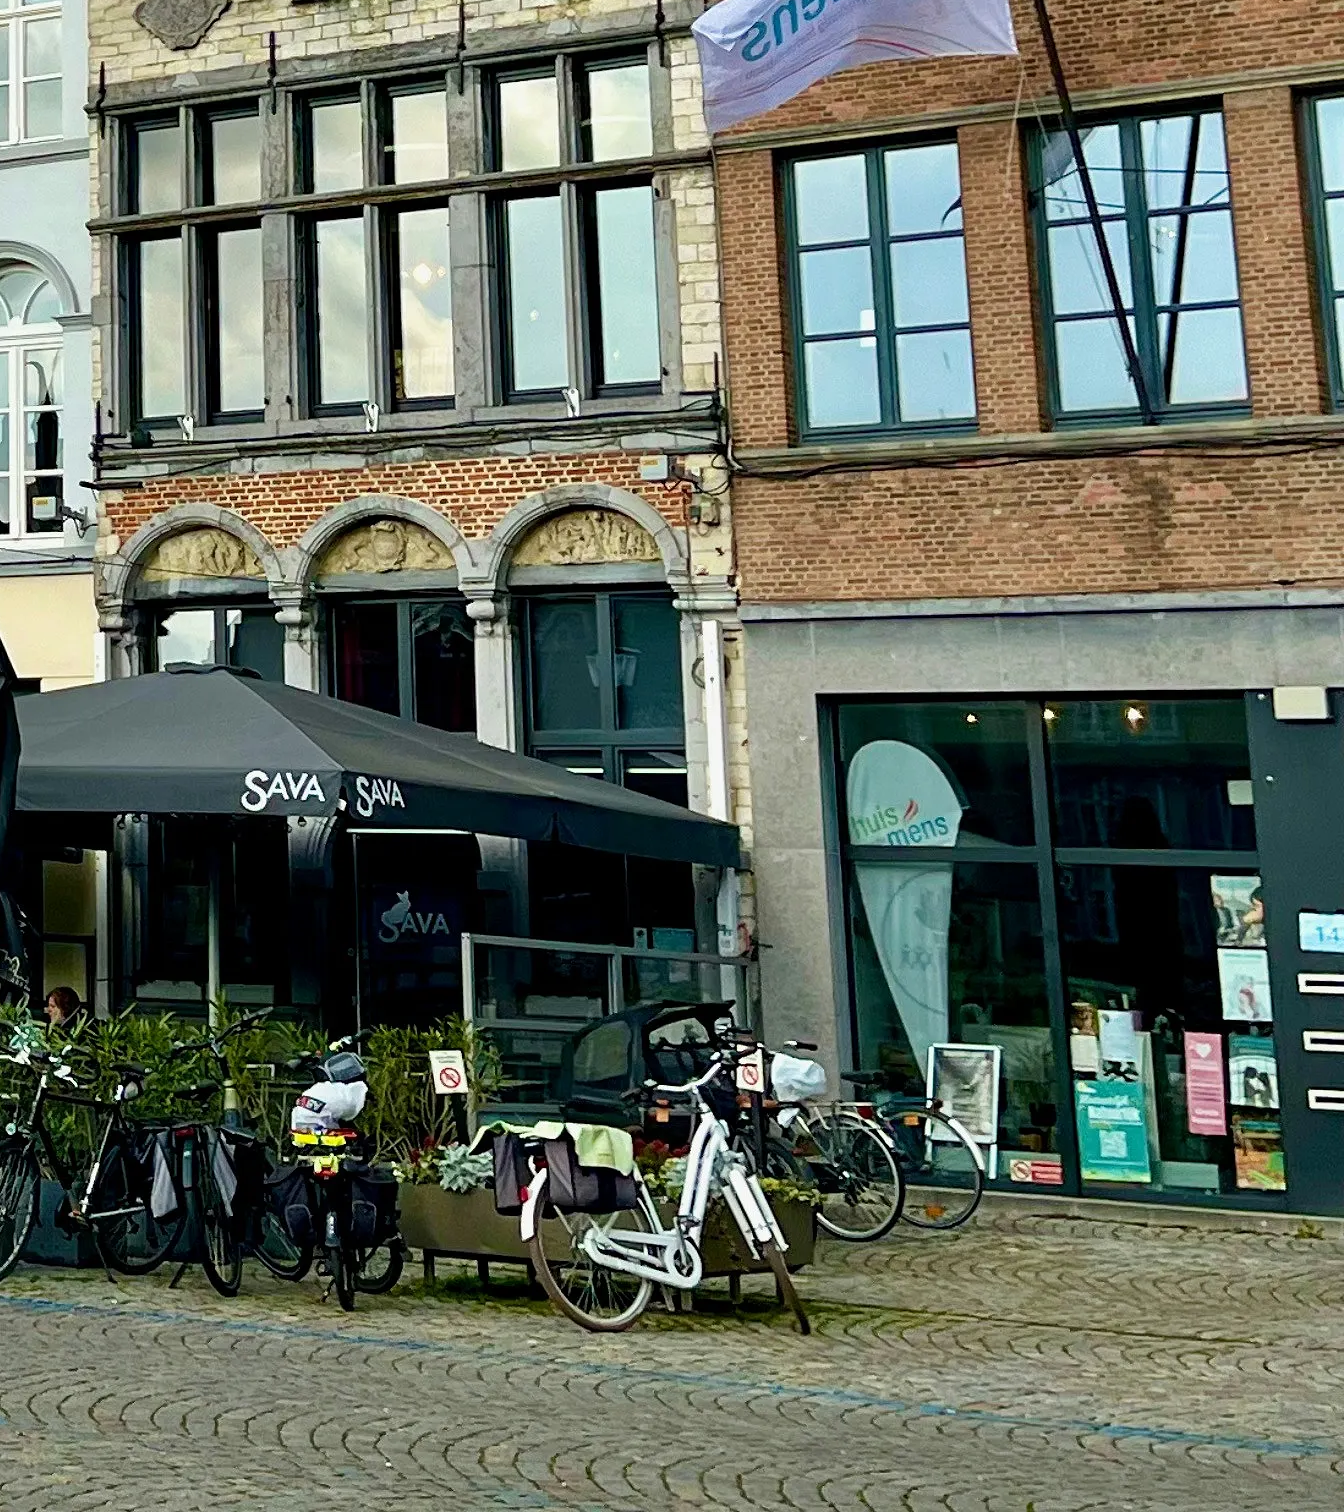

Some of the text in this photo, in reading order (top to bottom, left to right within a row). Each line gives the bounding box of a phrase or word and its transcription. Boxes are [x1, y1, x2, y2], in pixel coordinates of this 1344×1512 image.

[241, 770, 326, 812] SAVA
[356, 776, 406, 818] SAVA
[851, 804, 899, 840] huis
[887, 816, 949, 846] mens
[378, 895, 450, 943] SAVA
